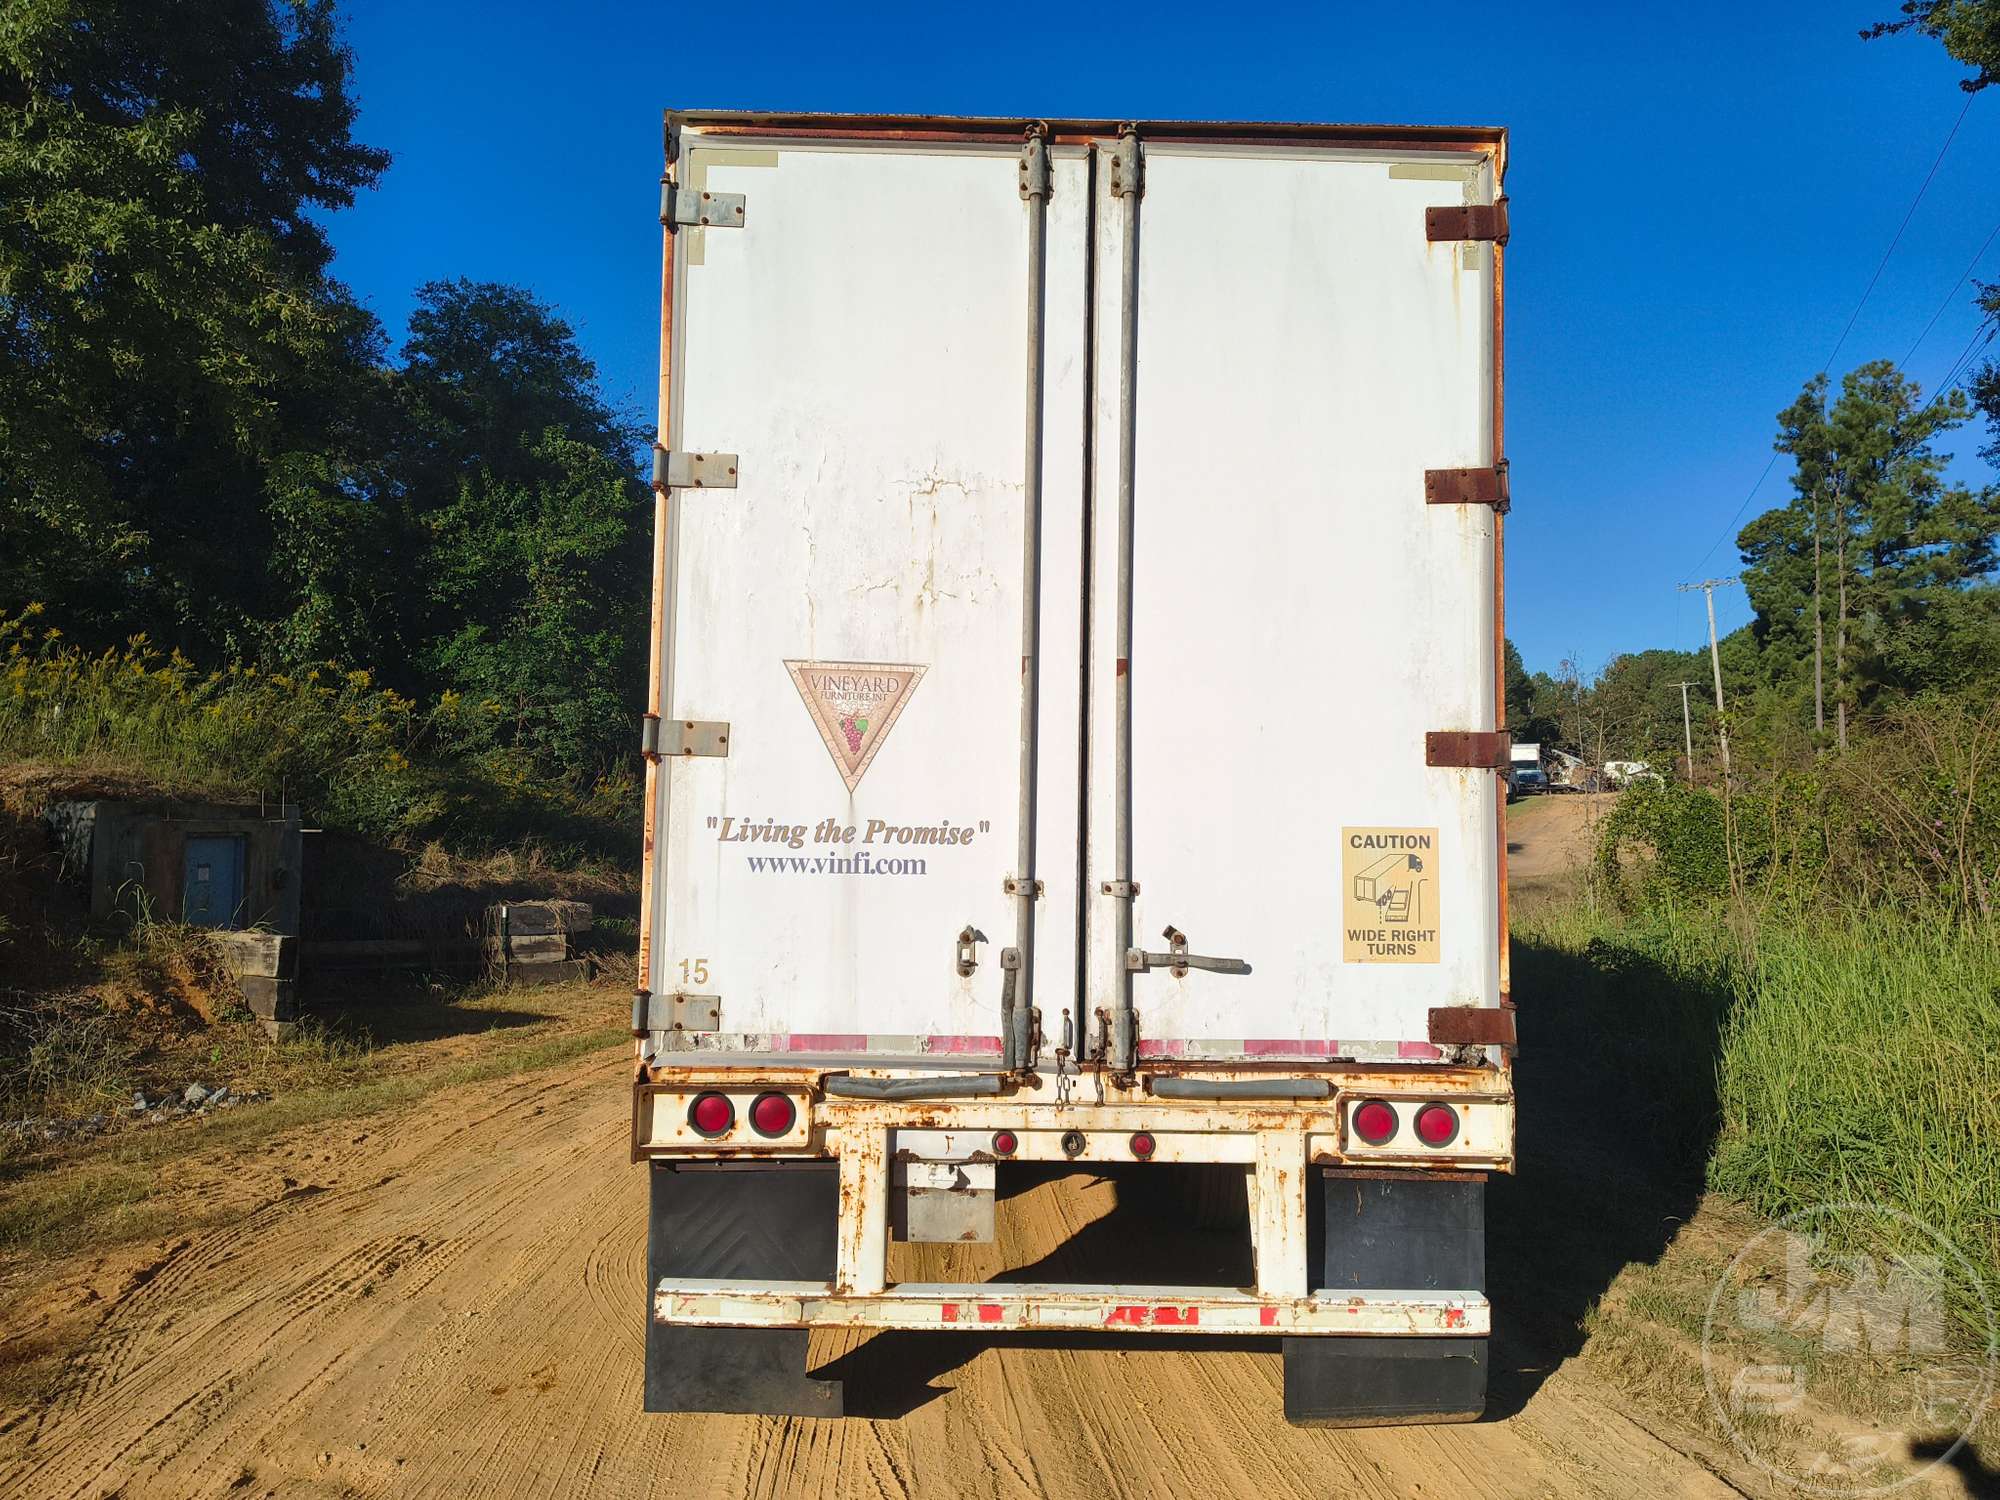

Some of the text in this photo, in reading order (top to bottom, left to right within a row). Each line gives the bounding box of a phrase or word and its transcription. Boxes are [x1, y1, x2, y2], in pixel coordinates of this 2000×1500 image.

[811, 674, 900, 693] VINEYARD
[706, 816, 991, 850] "Living the Promise"
[1350, 834, 1431, 849] CAUTION
[746, 851, 928, 876] www.vinfi.com
[1347, 929, 1436, 943] WIDE RIGHT
[1366, 943, 1417, 956] TURNS
[678, 958, 709, 985] 15
